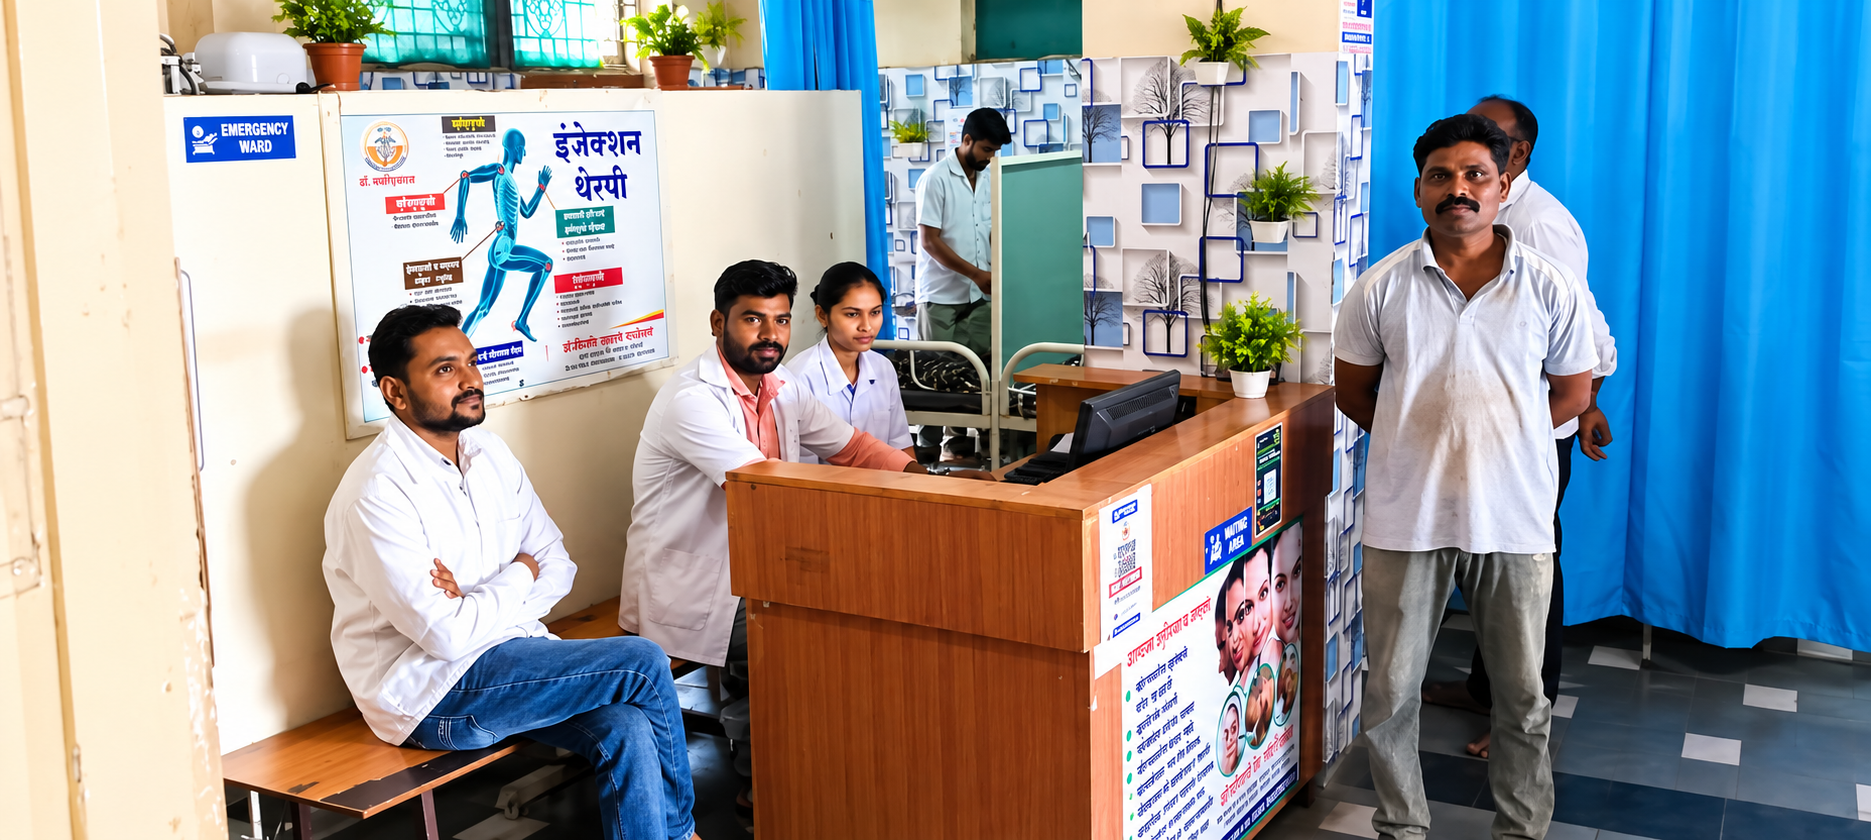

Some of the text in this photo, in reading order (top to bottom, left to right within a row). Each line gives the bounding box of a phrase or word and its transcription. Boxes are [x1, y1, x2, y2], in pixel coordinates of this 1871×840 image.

[220, 122, 289, 137] EMERGENCY
[239, 139, 273, 154] WARD
[552, 121, 642, 163] इंजेक्शन
[574, 164, 628, 202] थेरपी
[1224, 515, 1248, 540] WAITING
[1228, 533, 1245, 555] AREA
